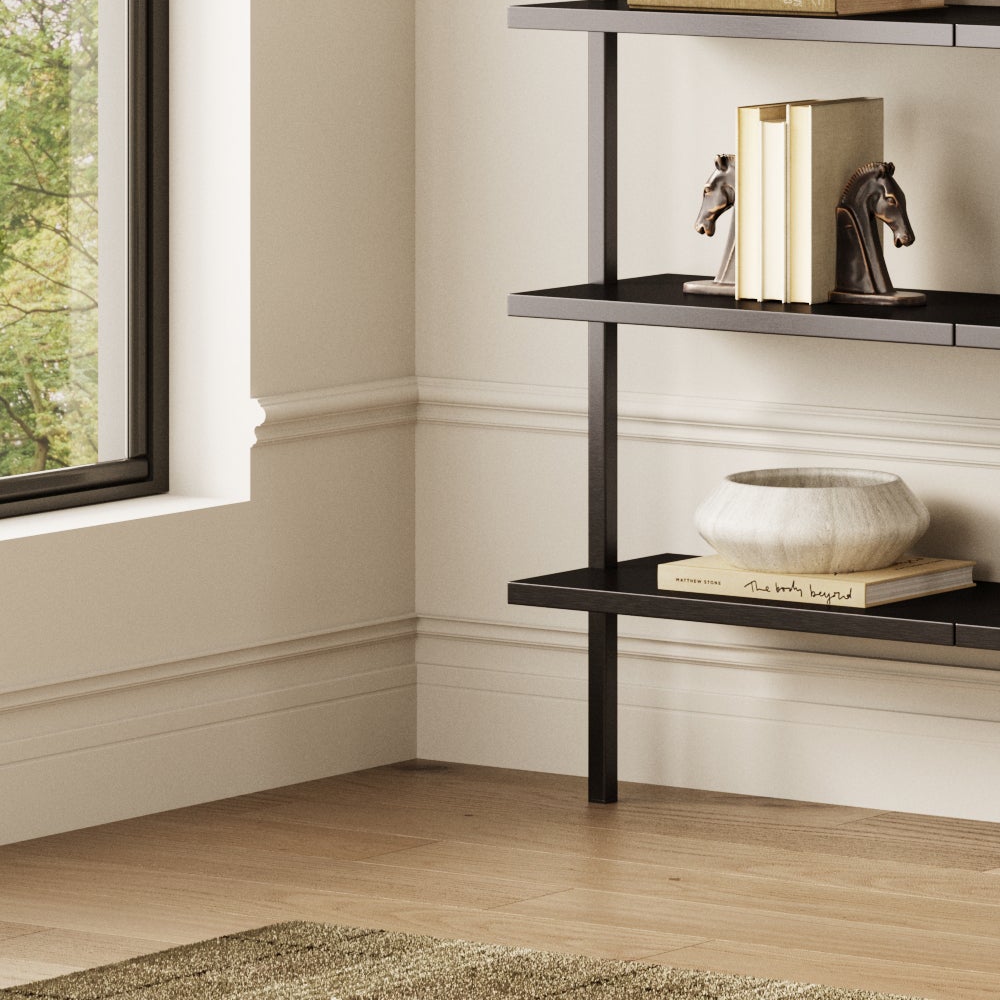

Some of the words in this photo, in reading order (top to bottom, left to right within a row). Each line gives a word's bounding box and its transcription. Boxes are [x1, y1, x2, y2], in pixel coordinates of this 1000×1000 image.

[744, 580, 771, 593] The
[775, 580, 803, 597] body
[809, 584, 853, 604] beyond
